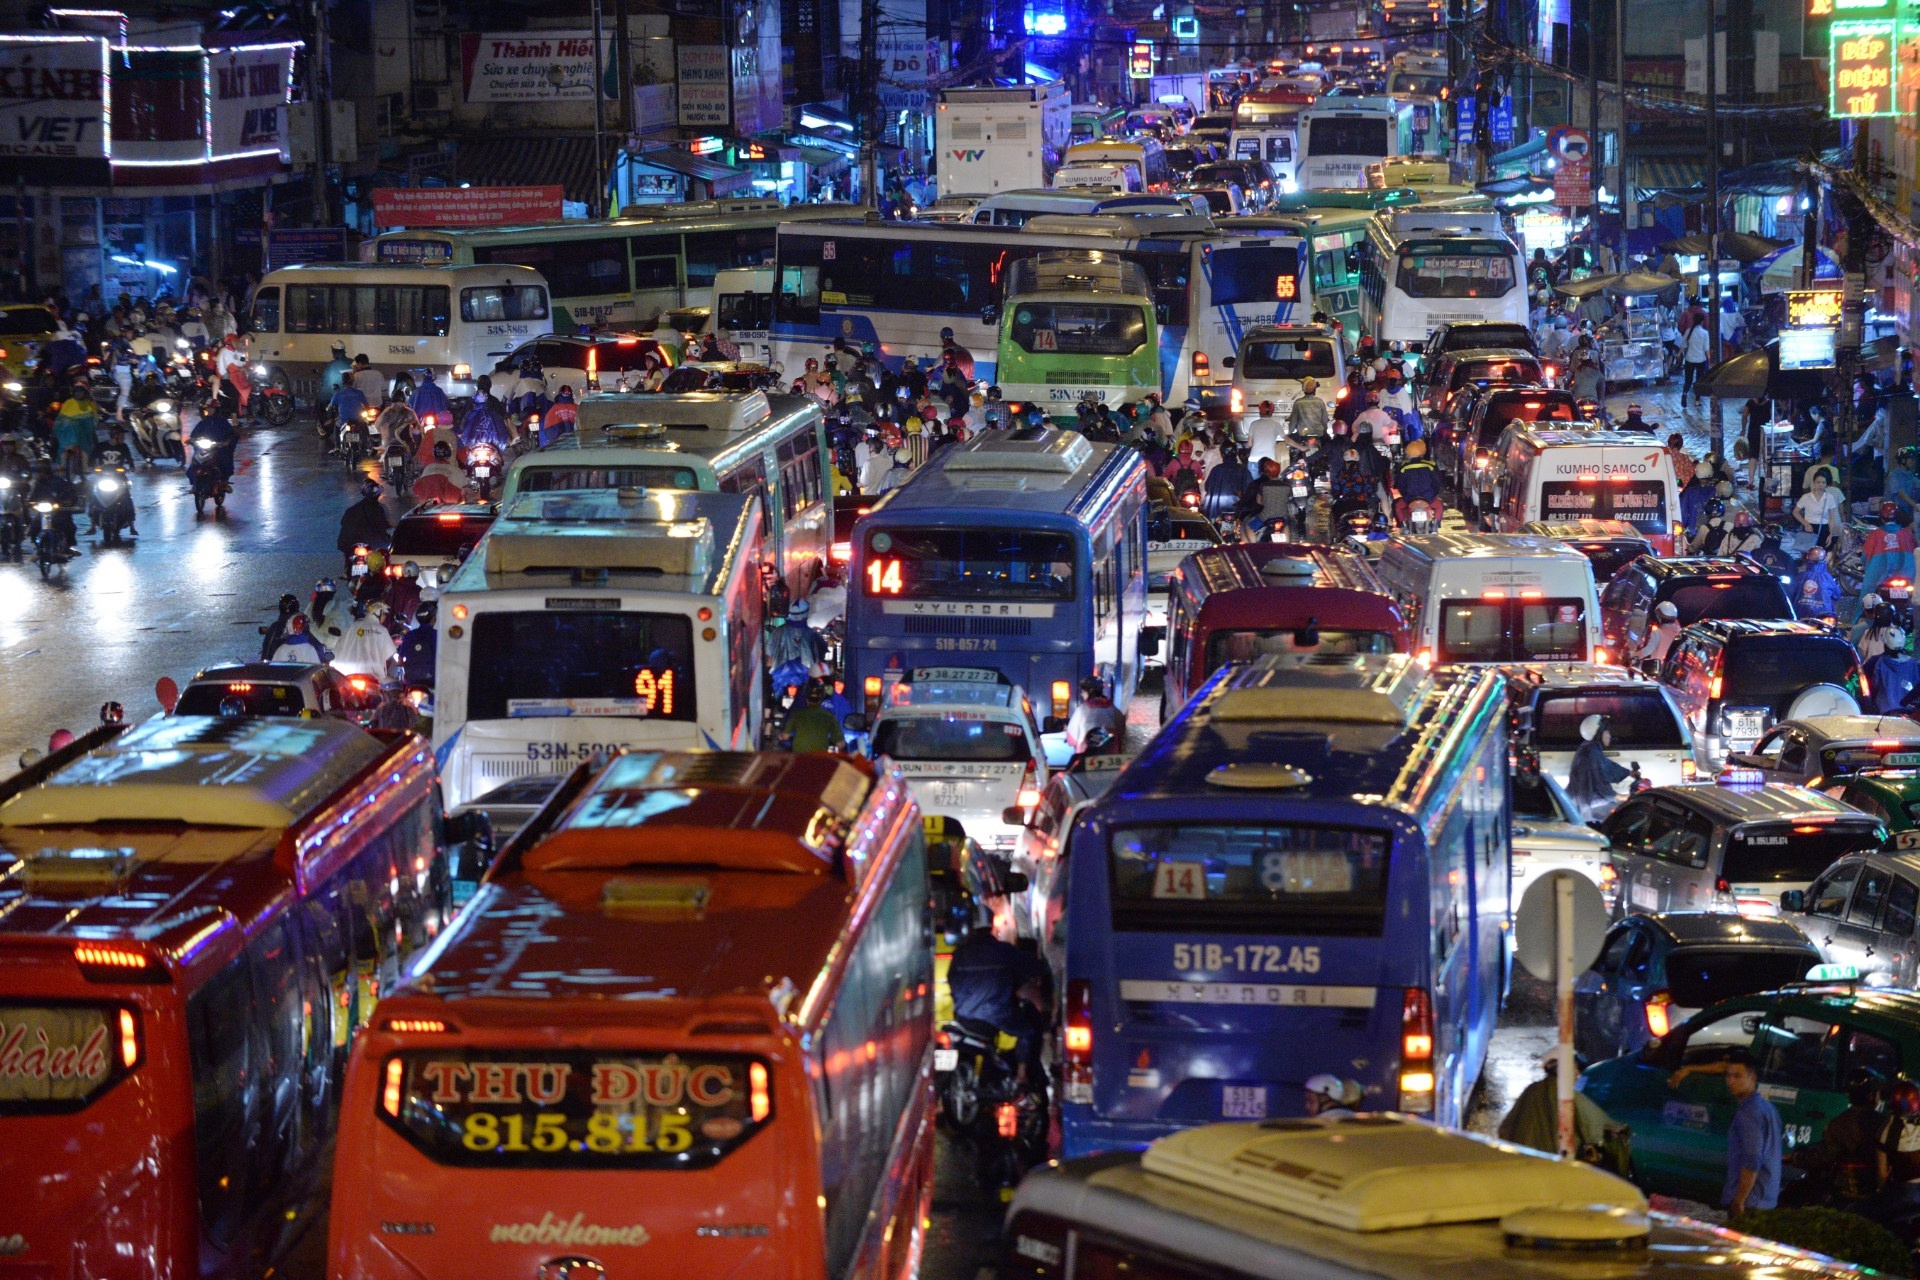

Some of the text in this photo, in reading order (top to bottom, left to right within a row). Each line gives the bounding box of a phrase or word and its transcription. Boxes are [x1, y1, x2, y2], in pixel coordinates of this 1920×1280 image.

[491, 41, 551, 59] Thành
[1842, 36, 1886, 60] BẾP
[507, 66, 519, 76] xe
[563, 62, 594, 78] nghiệ
[1839, 65, 1888, 90] ĐIỆN
[708, 112, 721, 121] MÍA
[952, 149, 985, 163] VTV
[1066, 175, 1112, 184] KUMHO SAMCO
[824, 242, 835, 258] 55
[1491, 257, 1507, 278] 54
[1036, 330, 1054, 349] 14
[1556, 463, 1646, 475] KUMHO SAMCO
[866, 559, 904, 594] 14
[968, 671, 980, 681] 27
[983, 671, 996, 681] 27
[636, 669, 674, 714] 91
[1738, 716, 1756, 727] 61H
[1735, 727, 1759, 738] 7930
[1894, 754, 1917, 764] TAXI
[924, 764, 942, 772] TAXI
[994, 765, 1008, 775] 27
[1009, 765, 1023, 774] 27
[1164, 868, 1195, 895] 14
[1172, 942, 1321, 974] 51B-172.45
[462, 1112, 694, 1153] 815.815
[490, 1212, 651, 1248] mobihome
